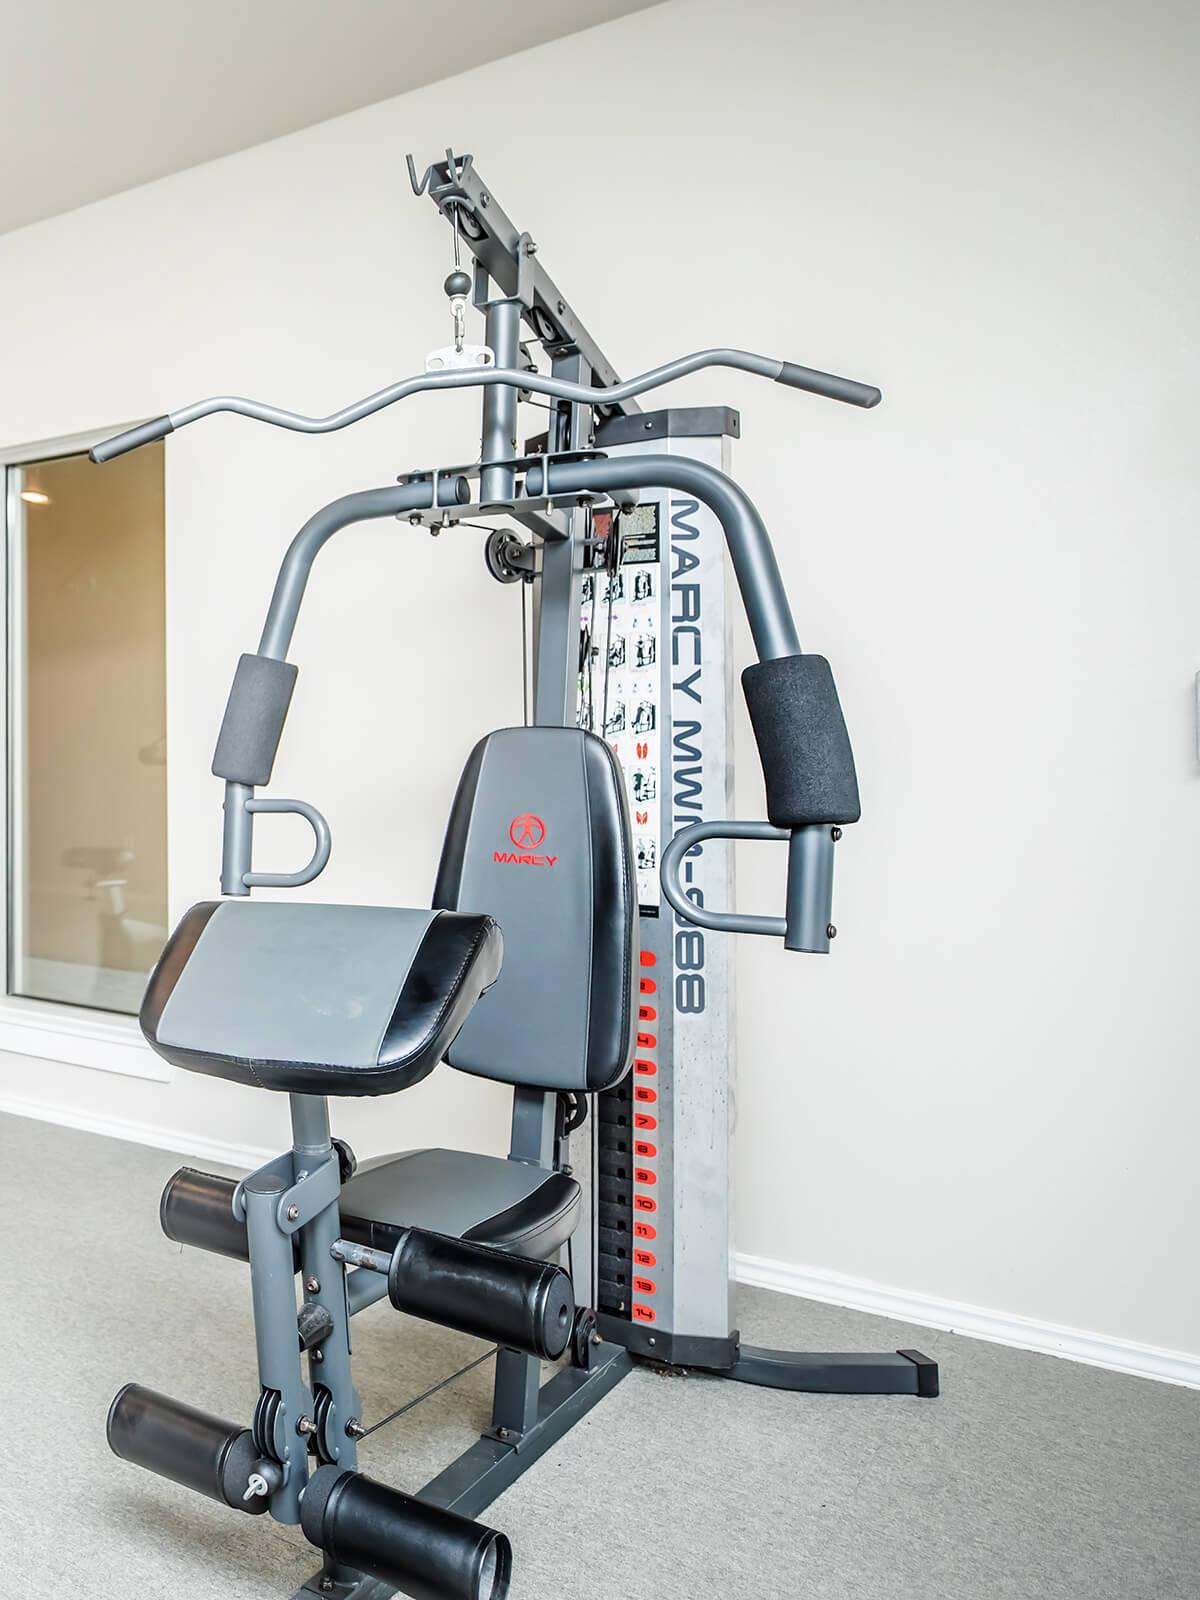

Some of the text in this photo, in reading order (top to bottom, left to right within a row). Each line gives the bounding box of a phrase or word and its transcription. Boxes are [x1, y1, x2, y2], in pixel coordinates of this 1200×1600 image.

[671, 500, 702, 704] MARCY
[493, 851, 558, 867] MARCY
[638, 1036, 648, 1044] 4
[638, 1117, 648, 1125] 7
[638, 1145, 648, 1154] 8
[638, 1172, 648, 1181] 9
[638, 1199, 653, 1210] 10
[638, 1226, 648, 1236] 11
[636, 1253, 650, 1264] 12
[636, 1280, 652, 1291] 13
[635, 1308, 653, 1319] 14
